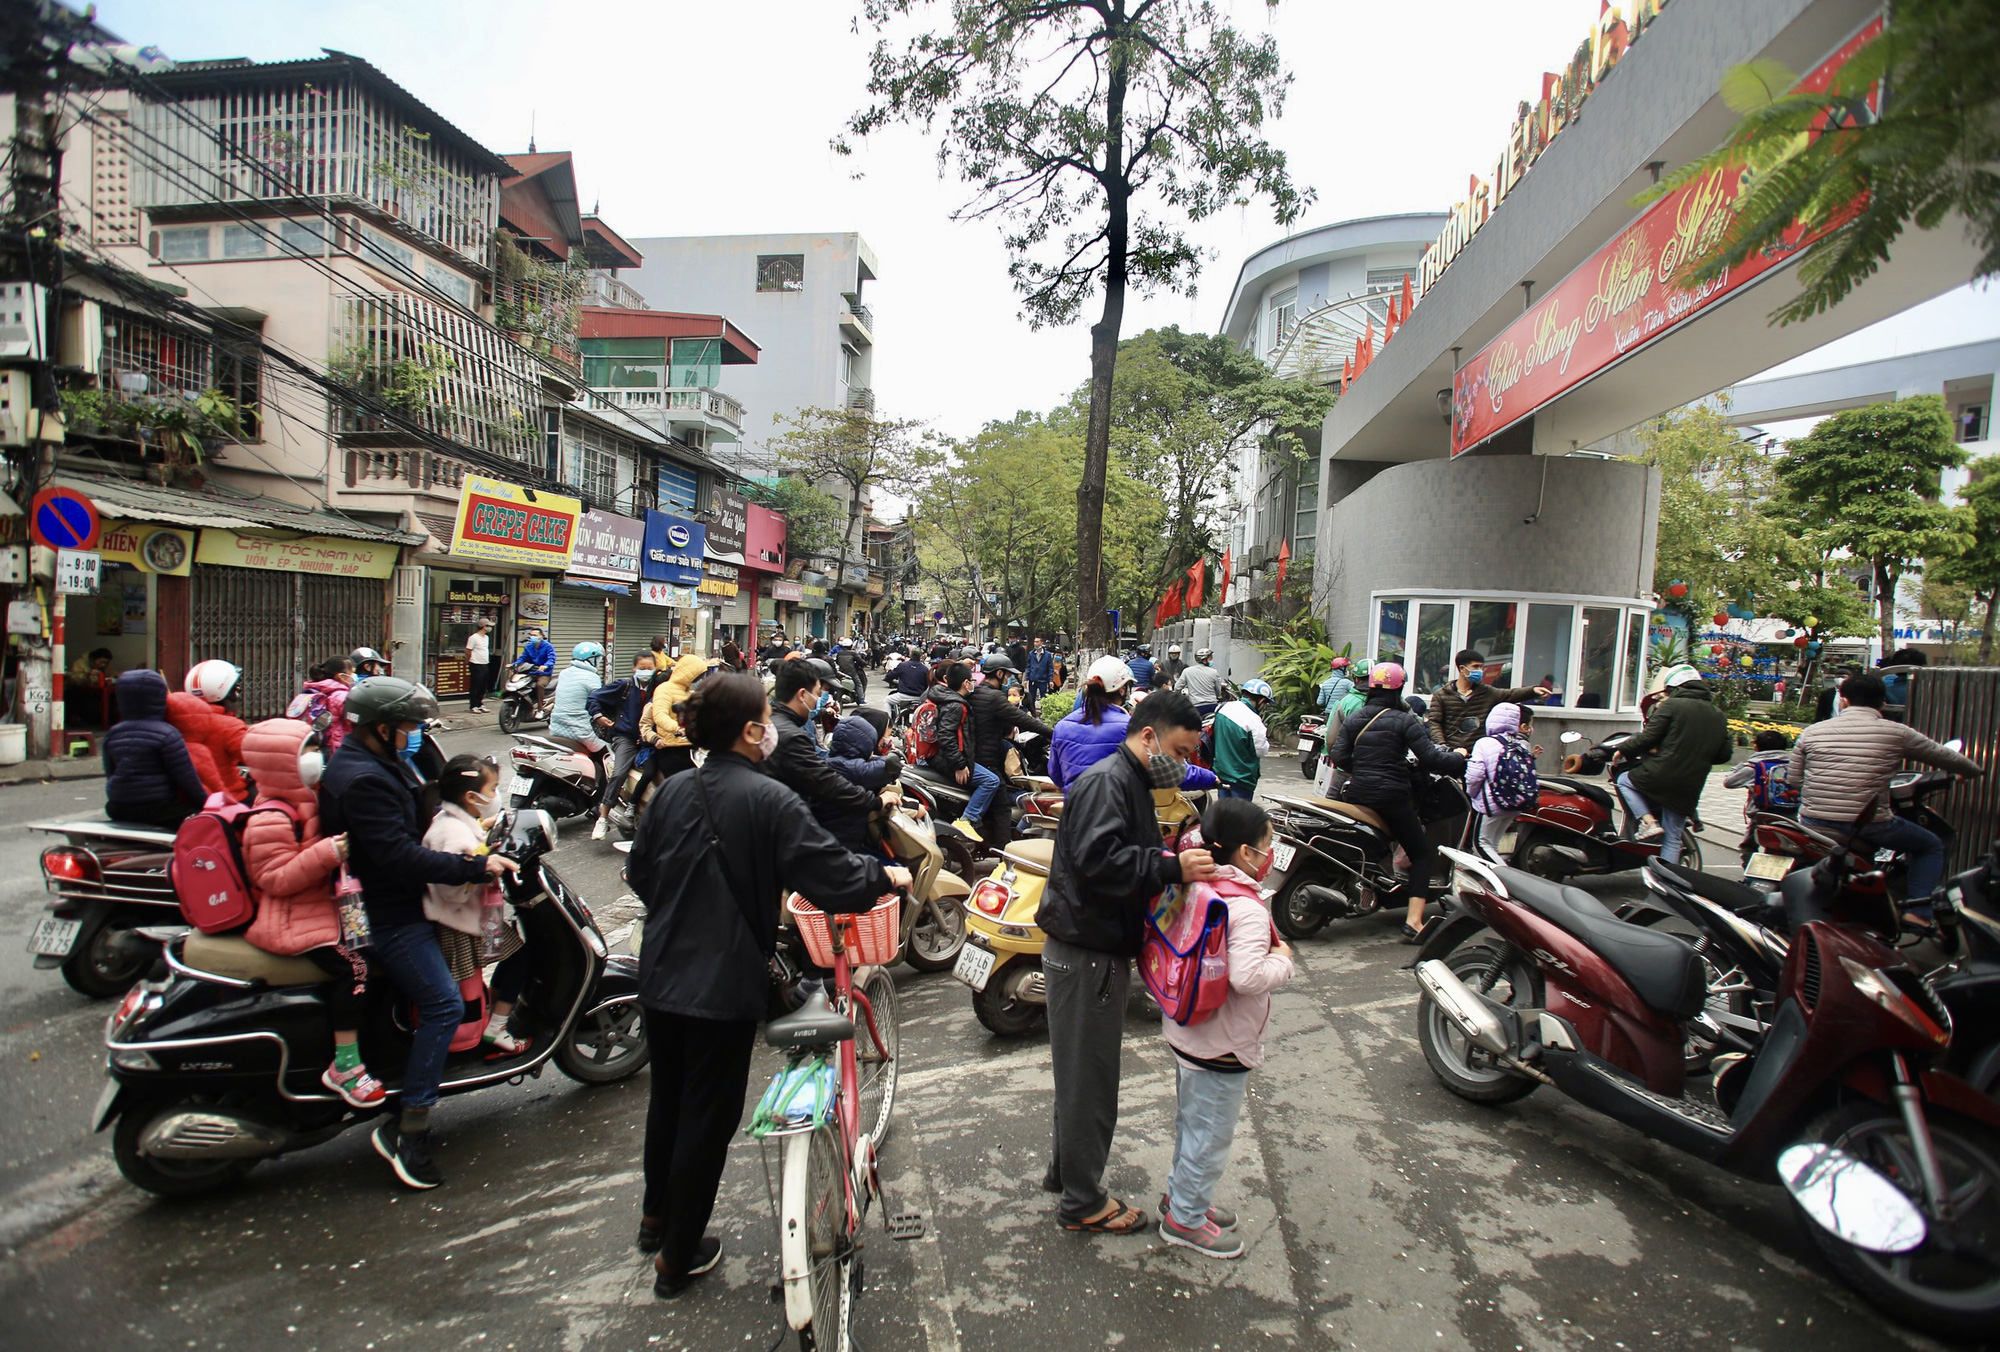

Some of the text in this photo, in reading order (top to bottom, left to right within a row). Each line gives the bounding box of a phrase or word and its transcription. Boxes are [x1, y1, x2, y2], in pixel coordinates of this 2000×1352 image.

[1613, 325, 1641, 354] Xuân
[1643, 308, 1665, 334] Tân
[1489, 341, 1523, 413] Chúc
[472, 502, 568, 547] CREPE CAKE
[575, 522, 591, 547] ÚN
[618, 536, 641, 557] NGAN
[316, 549, 348, 561] NAM
[467, 593, 485, 602] Crepe
[34, 702, 44, 713] 6
[964, 947, 990, 970] 30-L6
